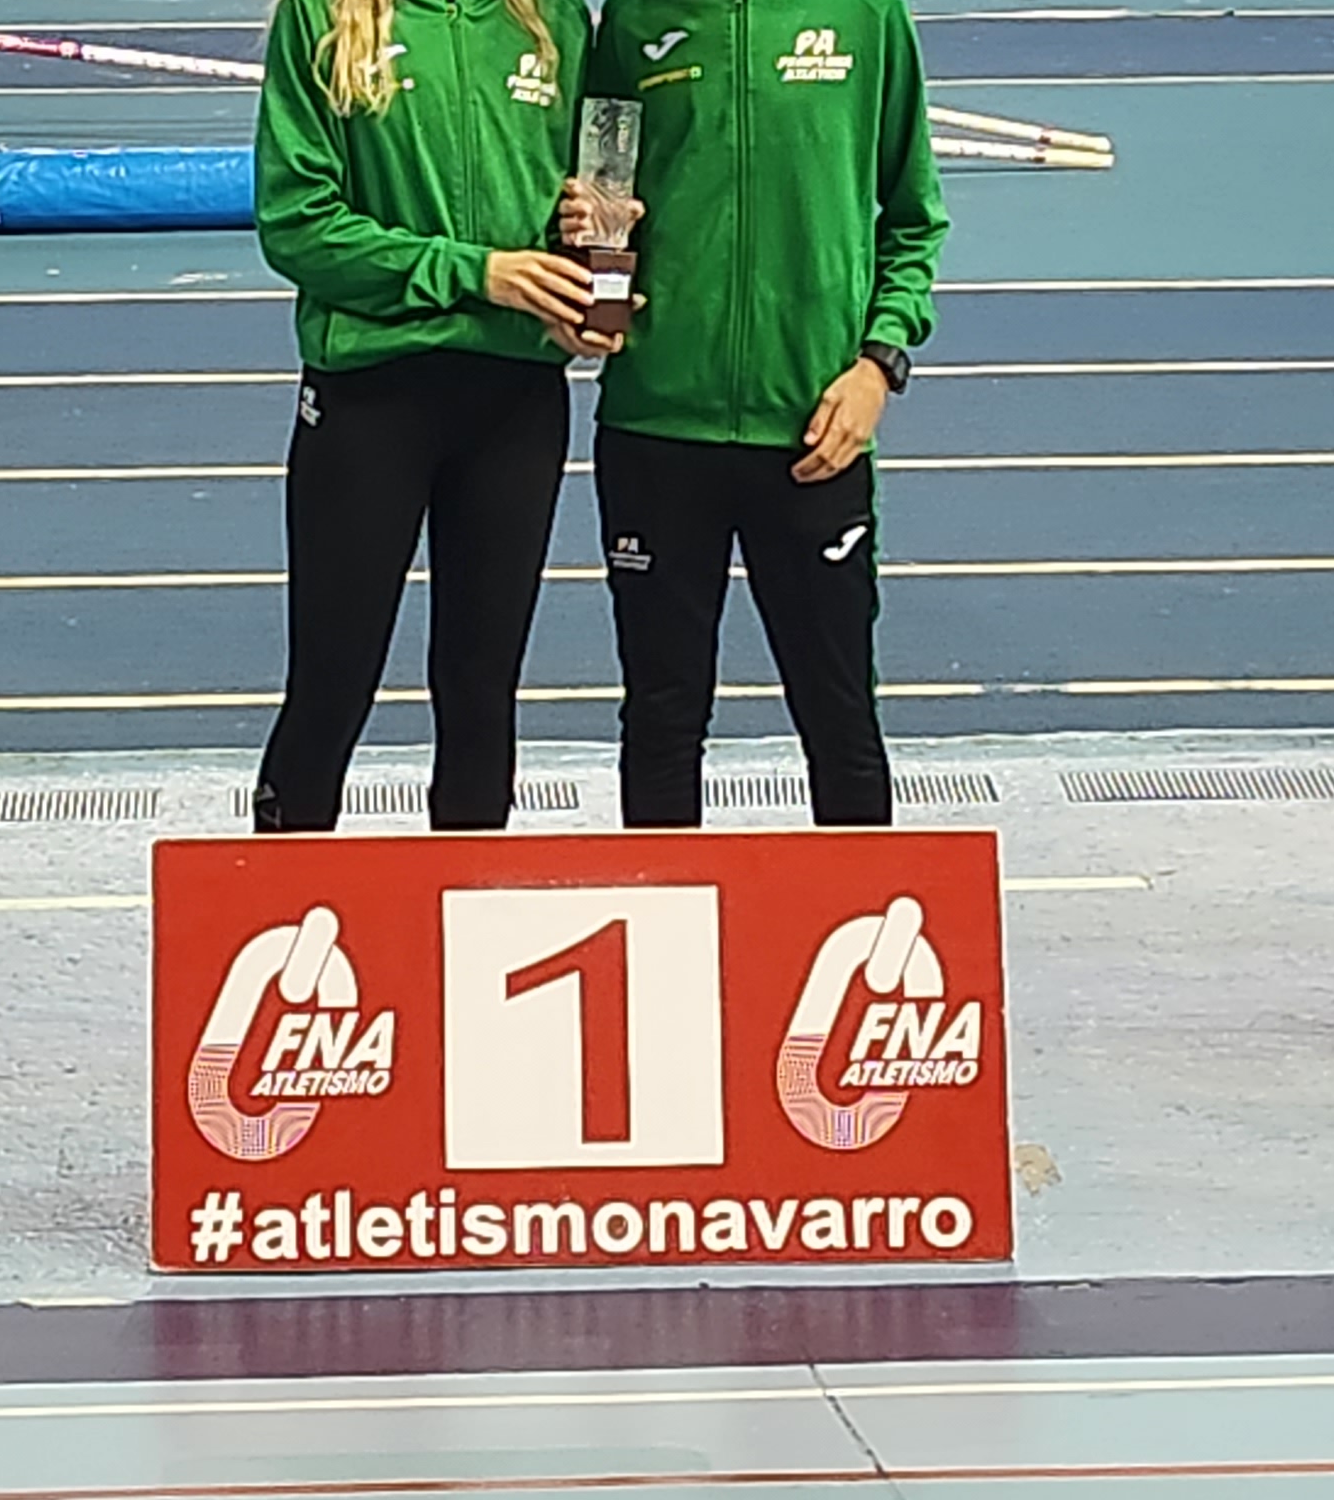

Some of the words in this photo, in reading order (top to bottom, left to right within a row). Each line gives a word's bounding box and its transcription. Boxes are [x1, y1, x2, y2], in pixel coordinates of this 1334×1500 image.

[794, 29, 836, 55] PA
[261, 1010, 395, 1072] FNA
[504, 918, 632, 1145] 1
[849, 1002, 981, 1062] FNA
[249, 1070, 391, 1097] ATLETISMO
[838, 1060, 978, 1088] ATLETISMO
[191, 1188, 974, 1262] #atletismonavarro
